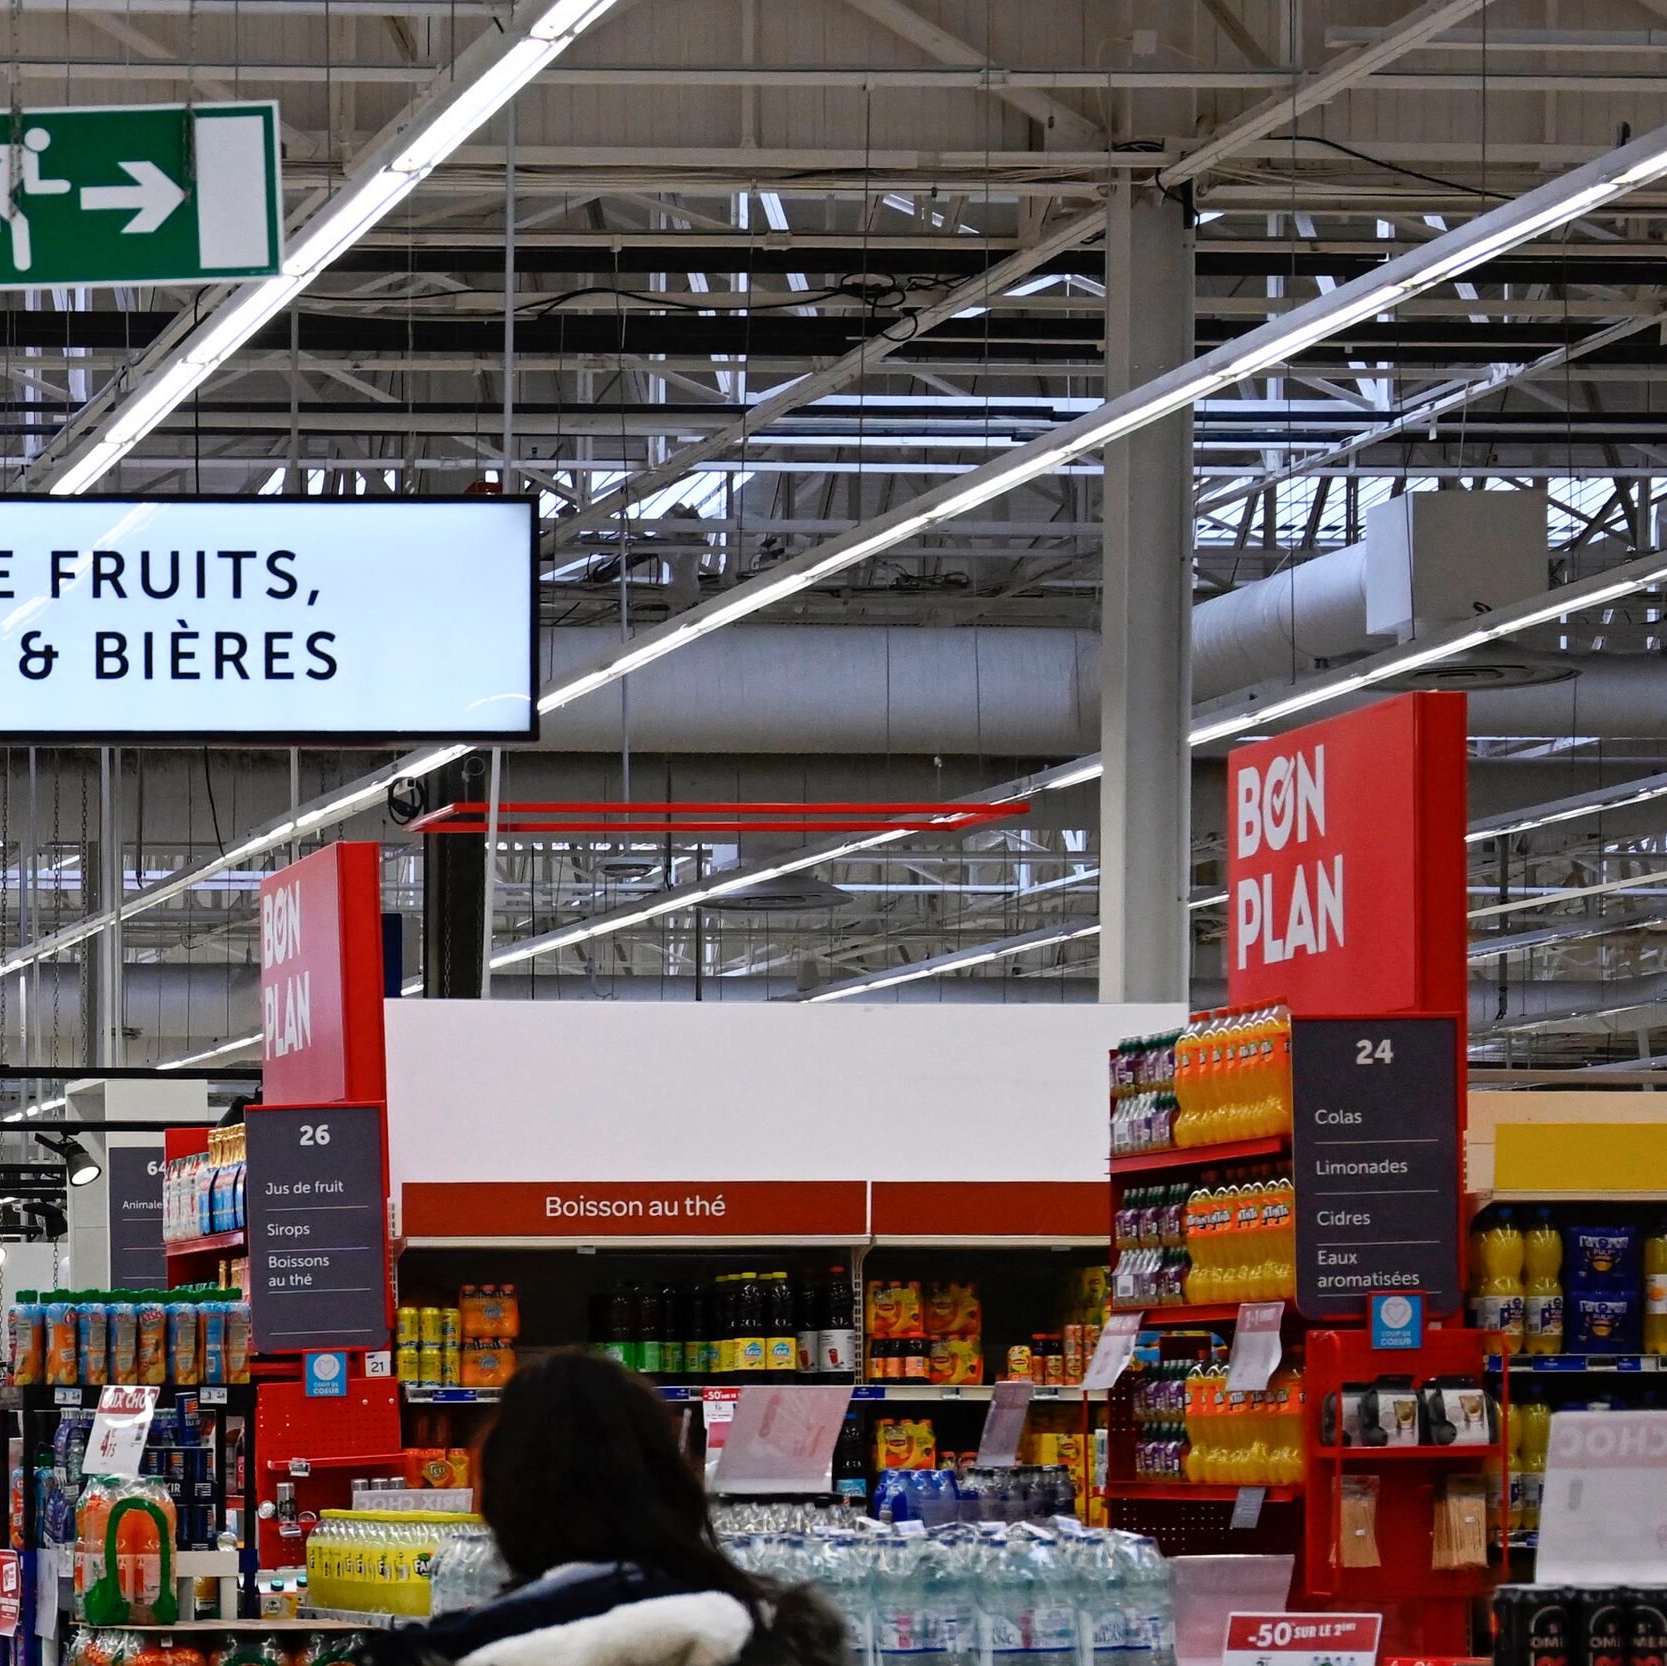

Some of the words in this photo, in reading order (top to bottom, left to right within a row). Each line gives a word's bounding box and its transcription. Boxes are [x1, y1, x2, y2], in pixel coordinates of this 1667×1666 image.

[51, 550, 319, 605] FRUITS,
[19, 631, 58, 680] &
[96, 619, 337, 680] BIÈRES
[1237, 744, 1325, 861] BON
[1237, 855, 1345, 971] PLAN
[264, 880, 301, 970] BON
[265, 971, 311, 1062] PLAN
[1355, 1040, 1393, 1065] 24
[1315, 1109, 1362, 1126] Colas
[299, 1124, 331, 1148] 26
[1315, 1159, 1408, 1175] Limonades
[266, 1182, 289, 1196] Jus
[291, 1182, 311, 1195] de
[315, 1180, 344, 1195] fruit
[546, 1195, 642, 1216] Boisson
[649, 1201, 678, 1216] au
[685, 1195, 725, 1216] thé
[1317, 1210, 1371, 1227] Cidres
[267, 1222, 310, 1239] Sirops
[268, 1254, 330, 1269] Boissons
[1317, 1250, 1357, 1266] Eaux
[268, 1276, 286, 1286] au
[289, 1272, 313, 1286] thé
[1317, 1270, 1420, 1288] aromatisées
[371, 1361, 385, 1372] 21
